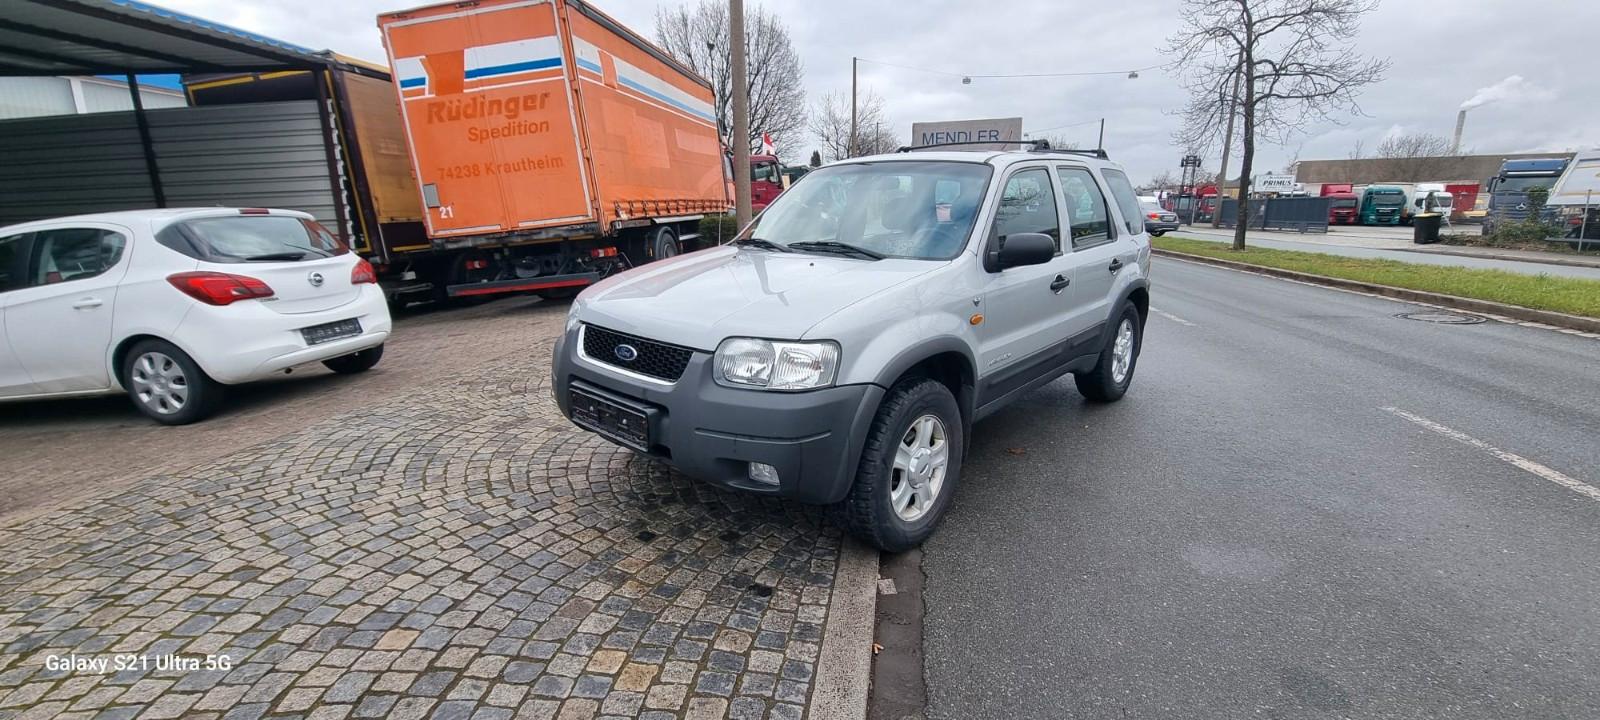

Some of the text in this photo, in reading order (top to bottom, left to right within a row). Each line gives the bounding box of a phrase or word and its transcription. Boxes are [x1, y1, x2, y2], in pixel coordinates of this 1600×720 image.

[427, 92, 551, 125] Rüdinger
[468, 120, 550, 143] Spedition
[922, 129, 1000, 145] MENDLER
[437, 155, 564, 180] 74238 Krautheim
[1263, 179, 1292, 187] PRIMUS
[439, 205, 454, 219] 21
